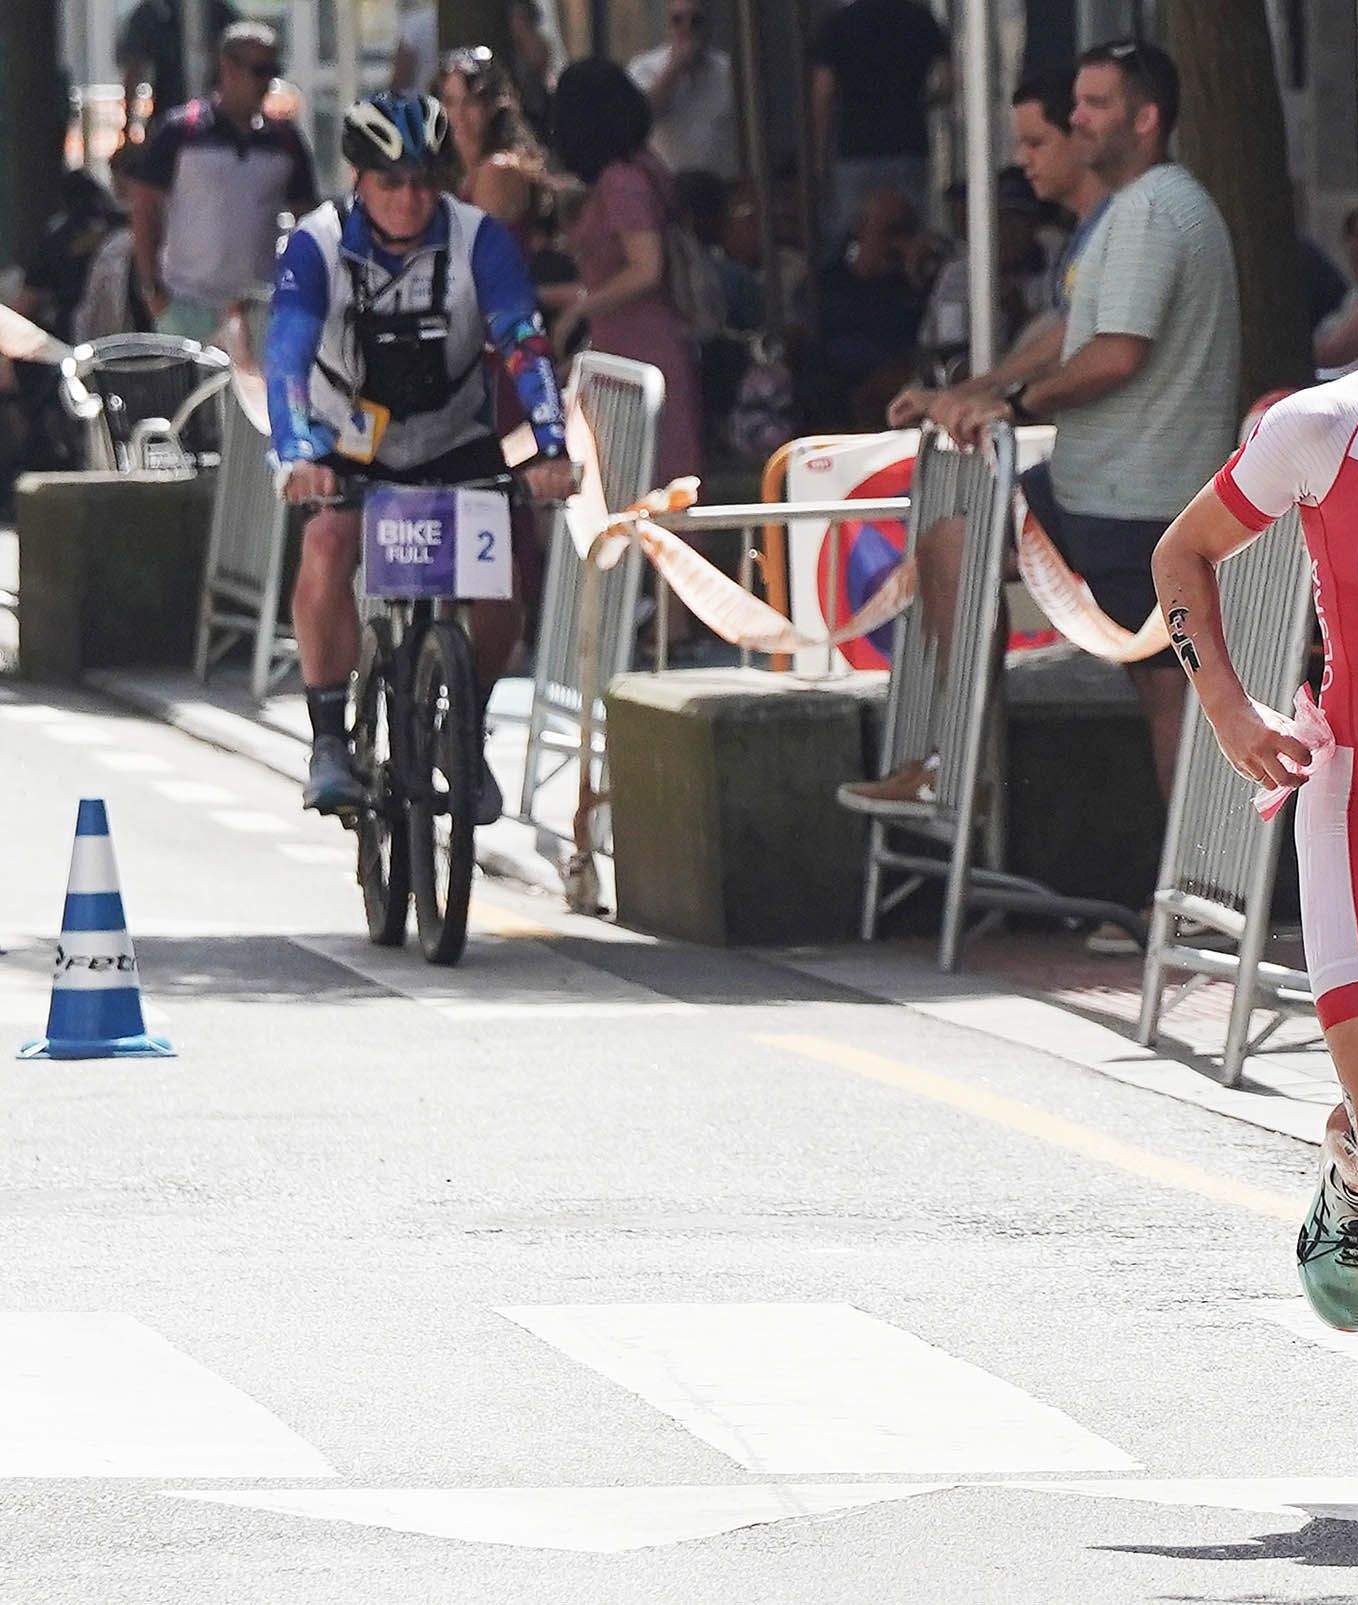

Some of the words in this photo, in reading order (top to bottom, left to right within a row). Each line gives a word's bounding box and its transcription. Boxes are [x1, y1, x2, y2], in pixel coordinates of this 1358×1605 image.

[377, 519, 442, 546] BIKE
[477, 530, 496, 562] 2
[385, 545, 434, 564] FULL
